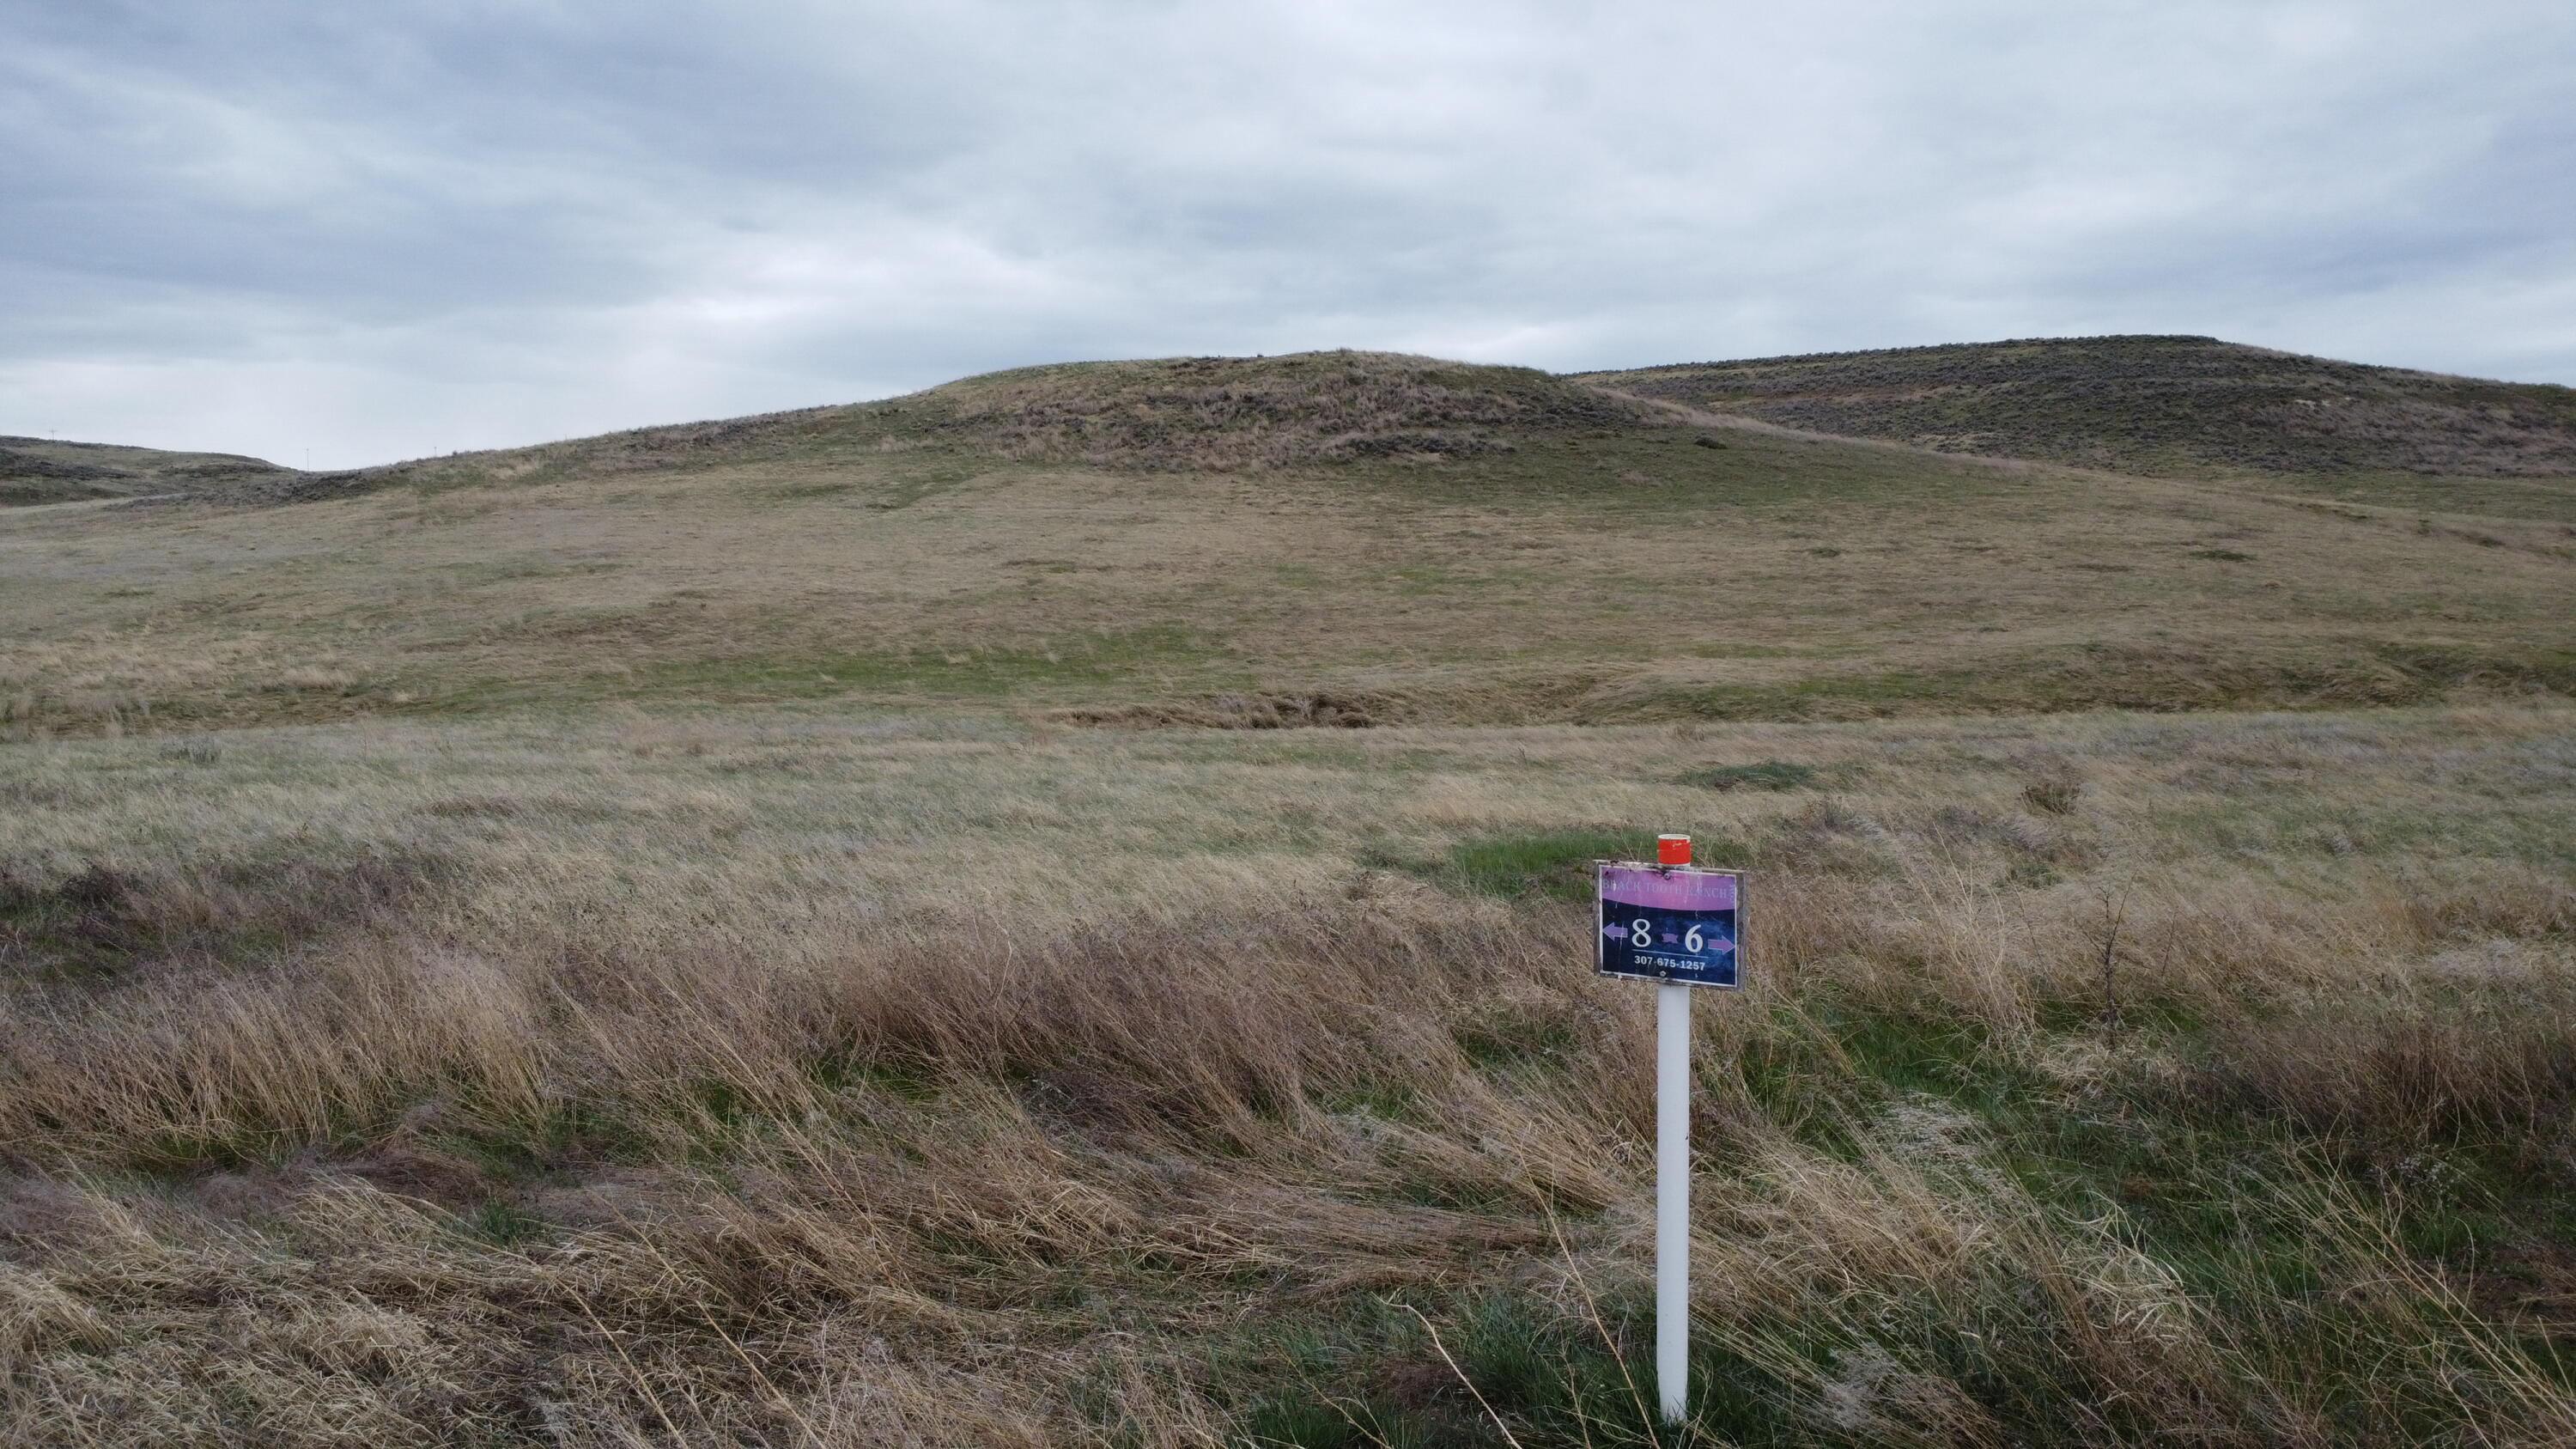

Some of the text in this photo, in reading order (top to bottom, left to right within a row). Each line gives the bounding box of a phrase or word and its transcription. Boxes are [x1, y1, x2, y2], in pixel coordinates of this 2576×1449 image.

[1631, 918, 1704, 953] 8 6
[1634, 955, 1705, 971] 307-675-1257
